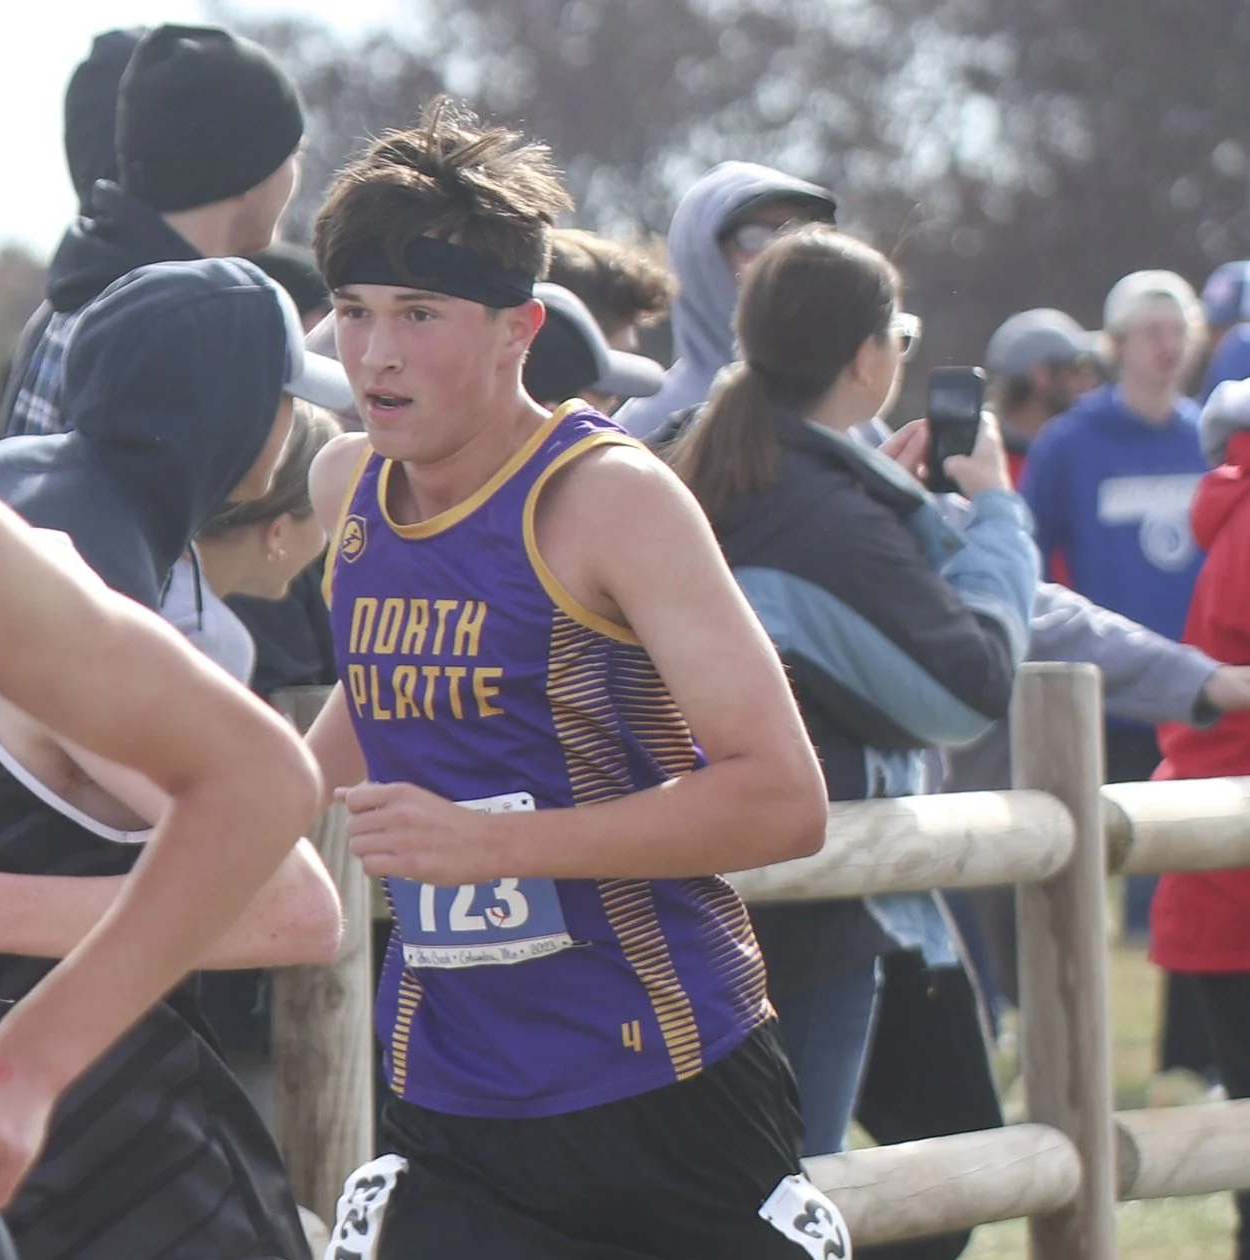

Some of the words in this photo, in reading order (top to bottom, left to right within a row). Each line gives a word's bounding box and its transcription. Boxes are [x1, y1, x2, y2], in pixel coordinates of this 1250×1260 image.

[348, 597, 487, 656] NORTH
[347, 664, 505, 721] PLATTE
[621, 1019, 642, 1052] 4
